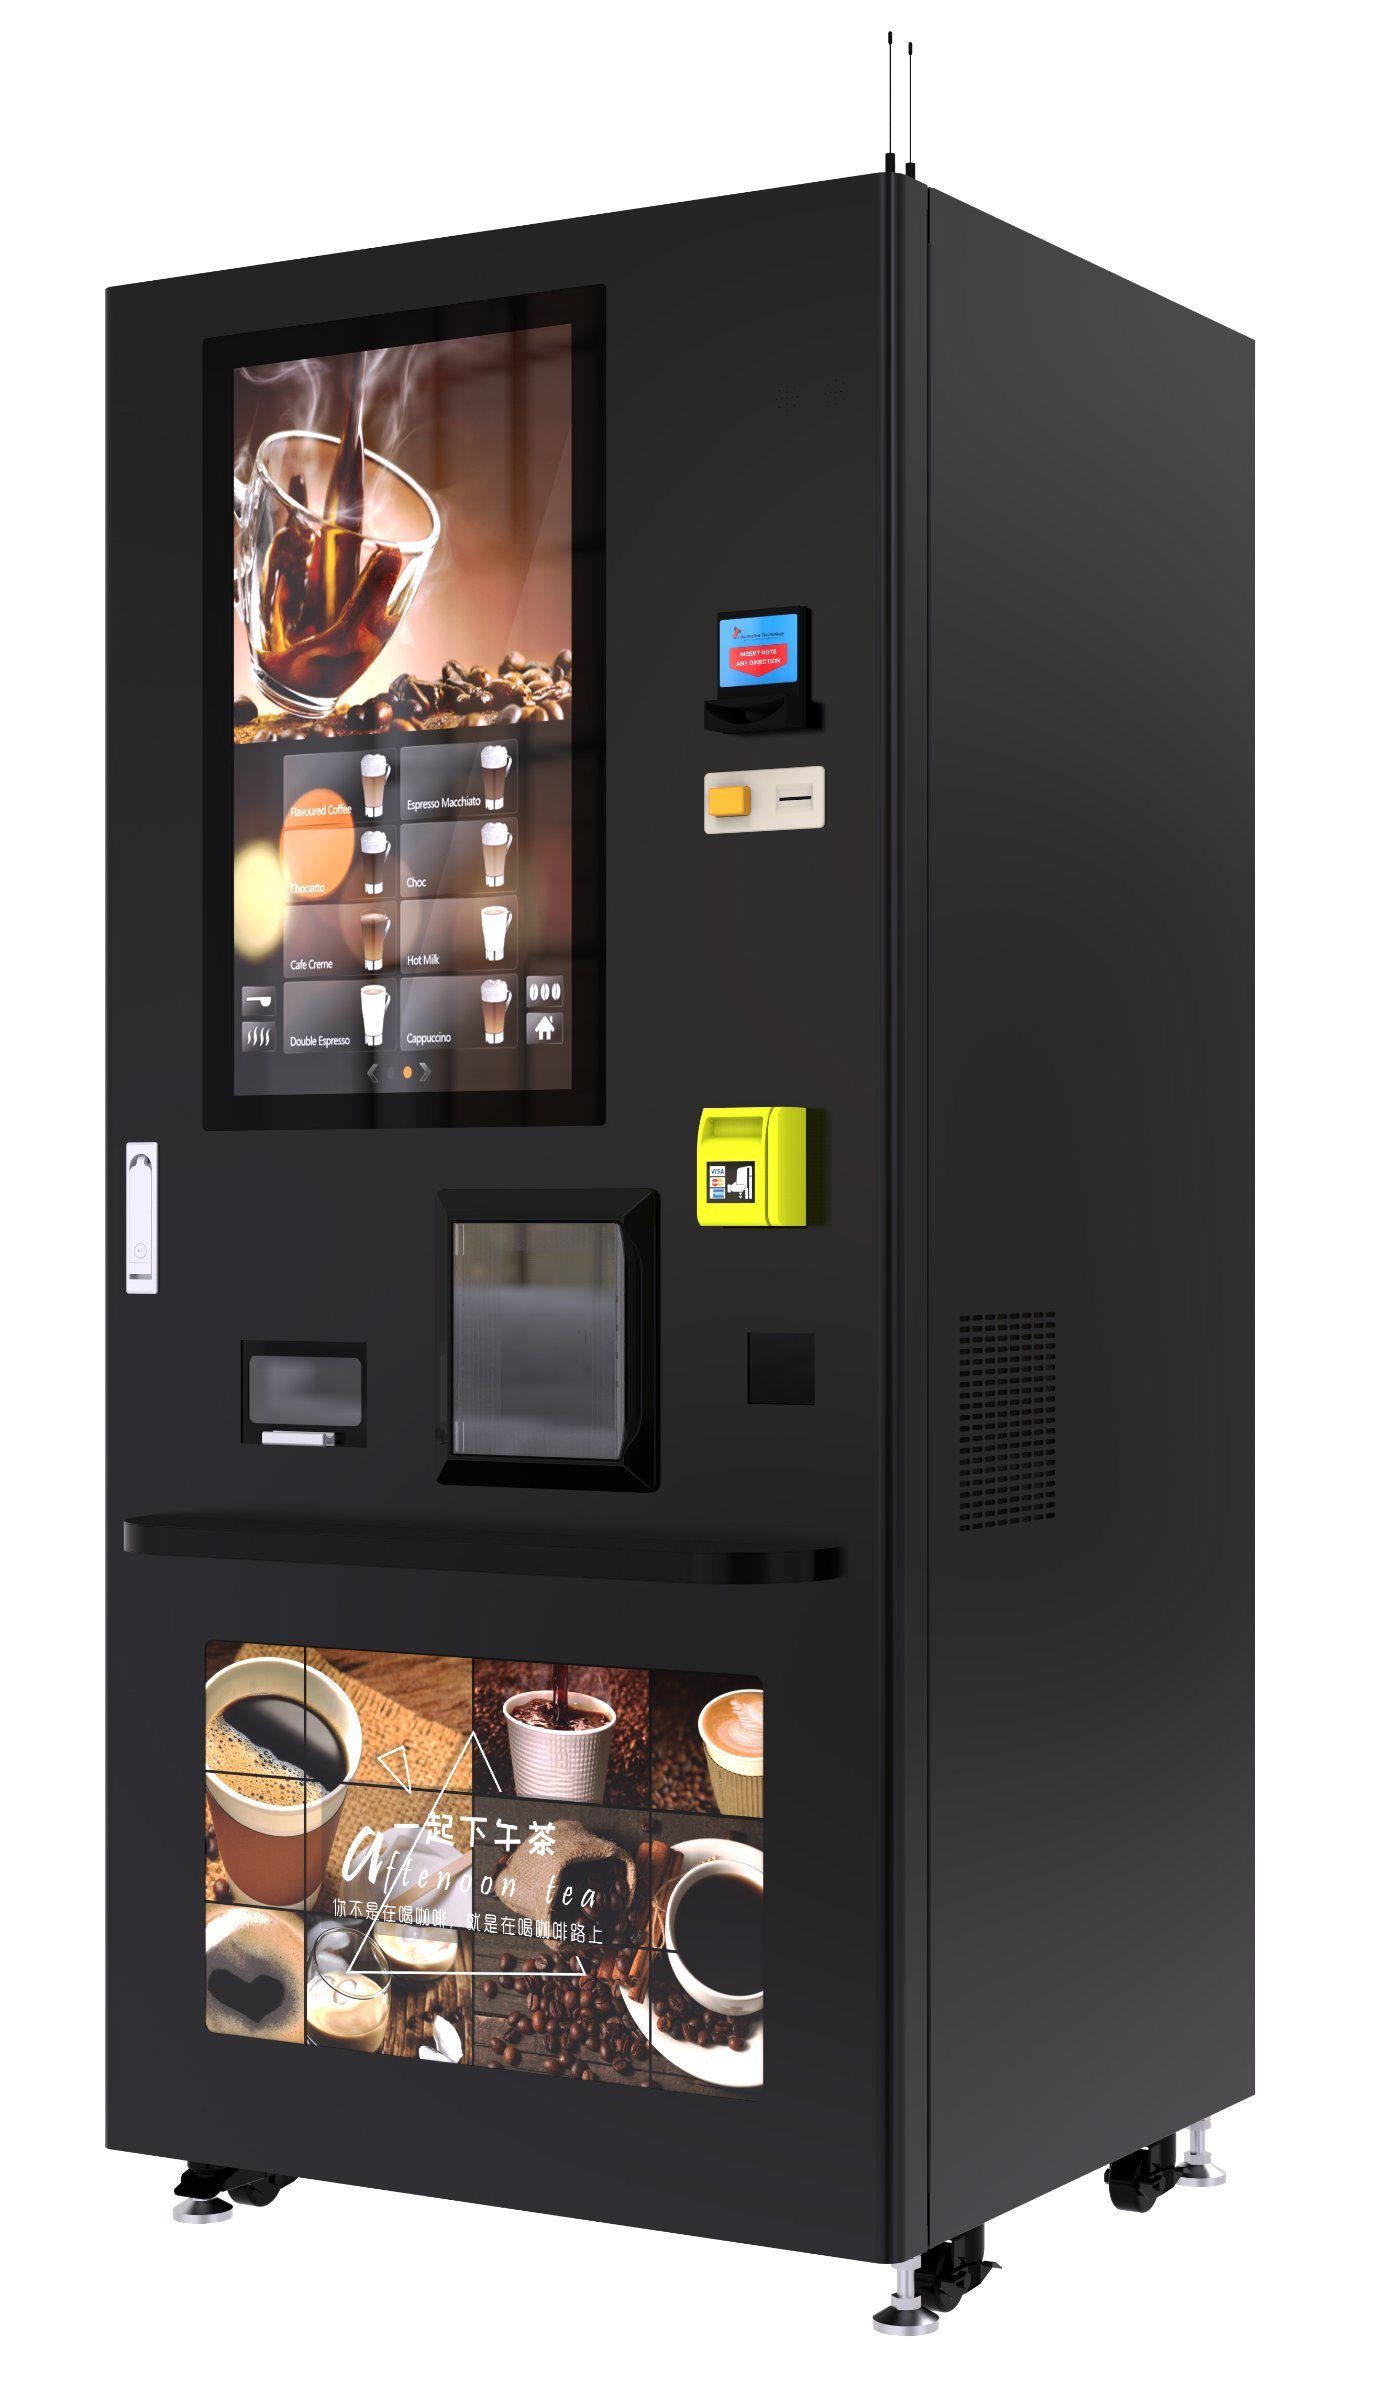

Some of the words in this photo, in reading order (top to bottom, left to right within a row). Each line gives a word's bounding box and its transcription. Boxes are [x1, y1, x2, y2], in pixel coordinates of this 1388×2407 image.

[749, 658, 781, 666] DIRECTION
[290, 806, 325, 817] Flavoured
[327, 804, 352, 815] Coffee
[407, 799, 439, 812] Espresso
[441, 796, 481, 807] Macchiato
[406, 876, 427, 888] Choc
[290, 960, 307, 970] Cafe
[309, 959, 333, 969] Creme
[407, 955, 422, 966] Hot
[423, 953, 440, 965] Milk
[290, 1036, 317, 1047] Double
[318, 1034, 351, 1048] Espresso
[406, 1032, 452, 1044] Cappuccino
[394, 1812, 556, 1856] 一起下午茶
[545, 1874, 596, 1909] tea
